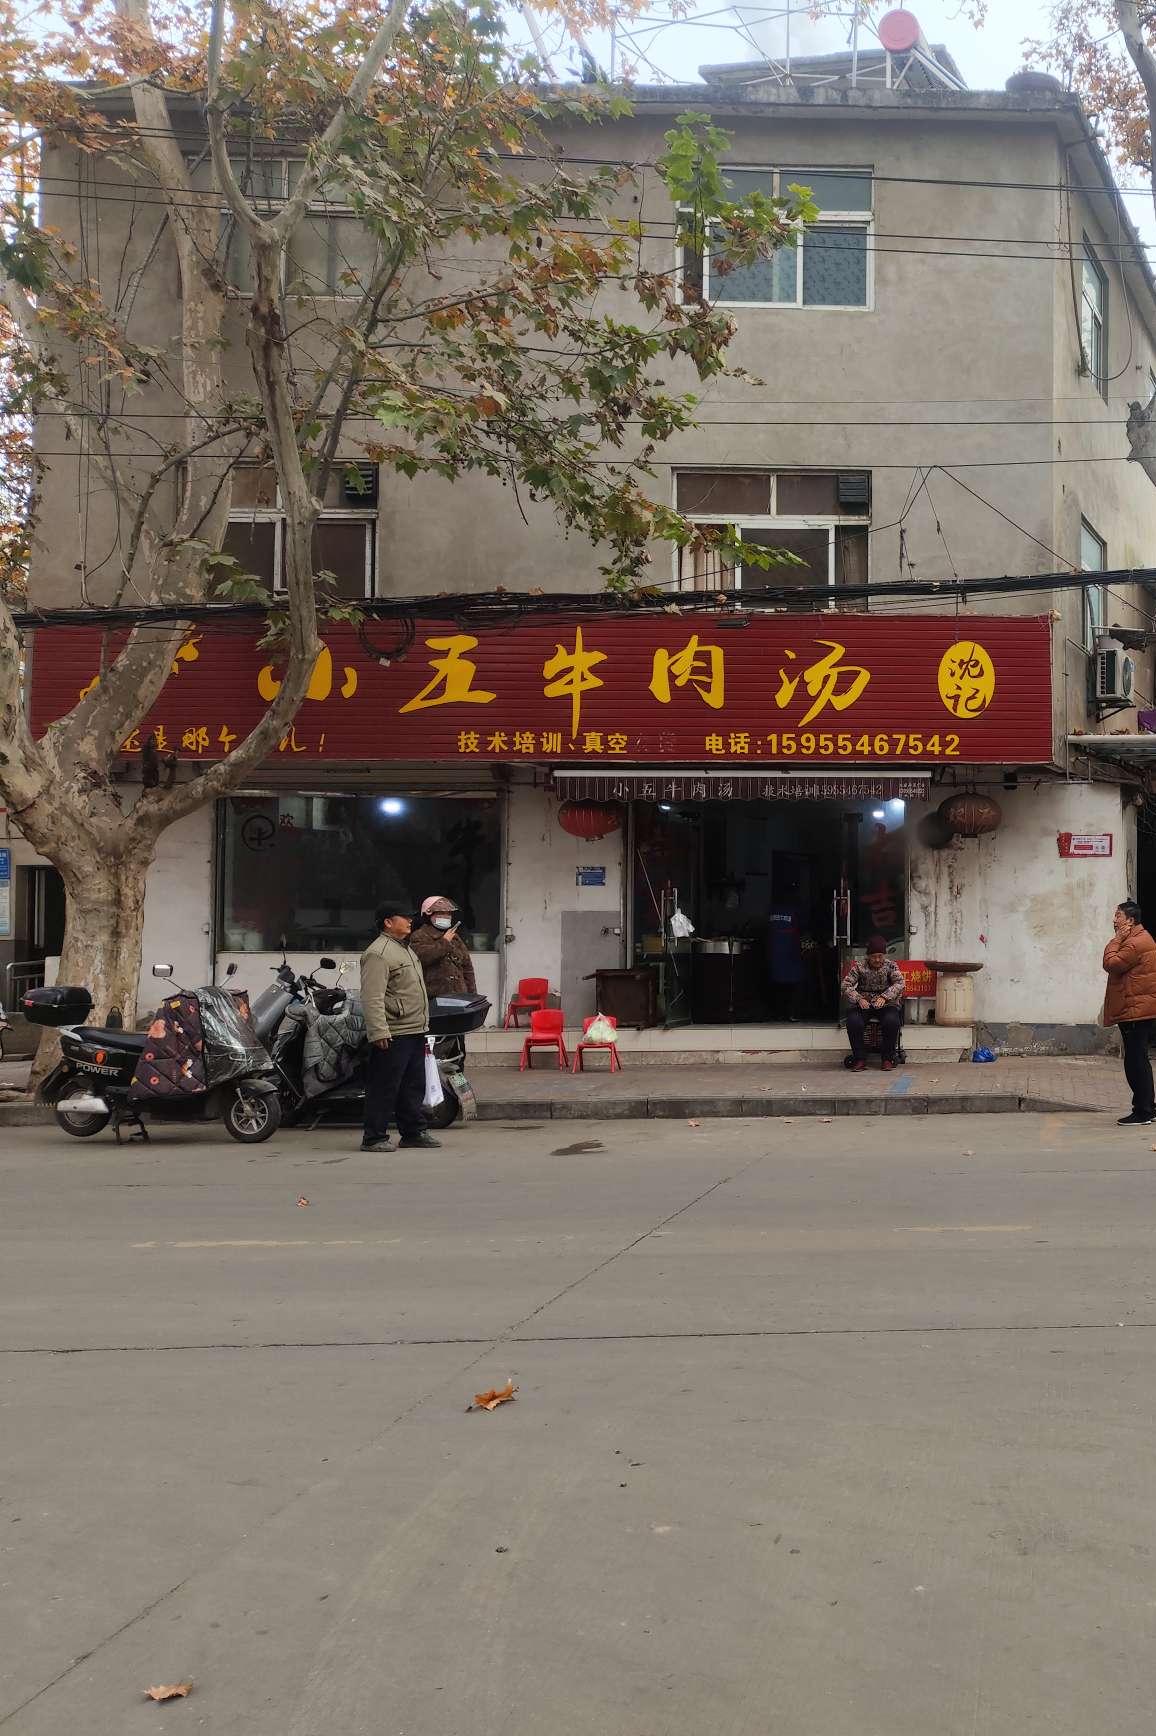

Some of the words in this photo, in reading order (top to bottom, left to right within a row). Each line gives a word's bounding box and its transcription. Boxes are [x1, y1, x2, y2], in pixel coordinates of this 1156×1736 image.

[80, 625, 871, 738] 小五牛肉汤
[120, 725, 326, 753] 还是那个儿!
[457, 731, 674, 754] 技术培训、真空
[705, 733, 961, 755] 电话:15955467542
[613, 782, 733, 798] 小五牛肉汤
[76, 1062, 119, 1076] POWER
